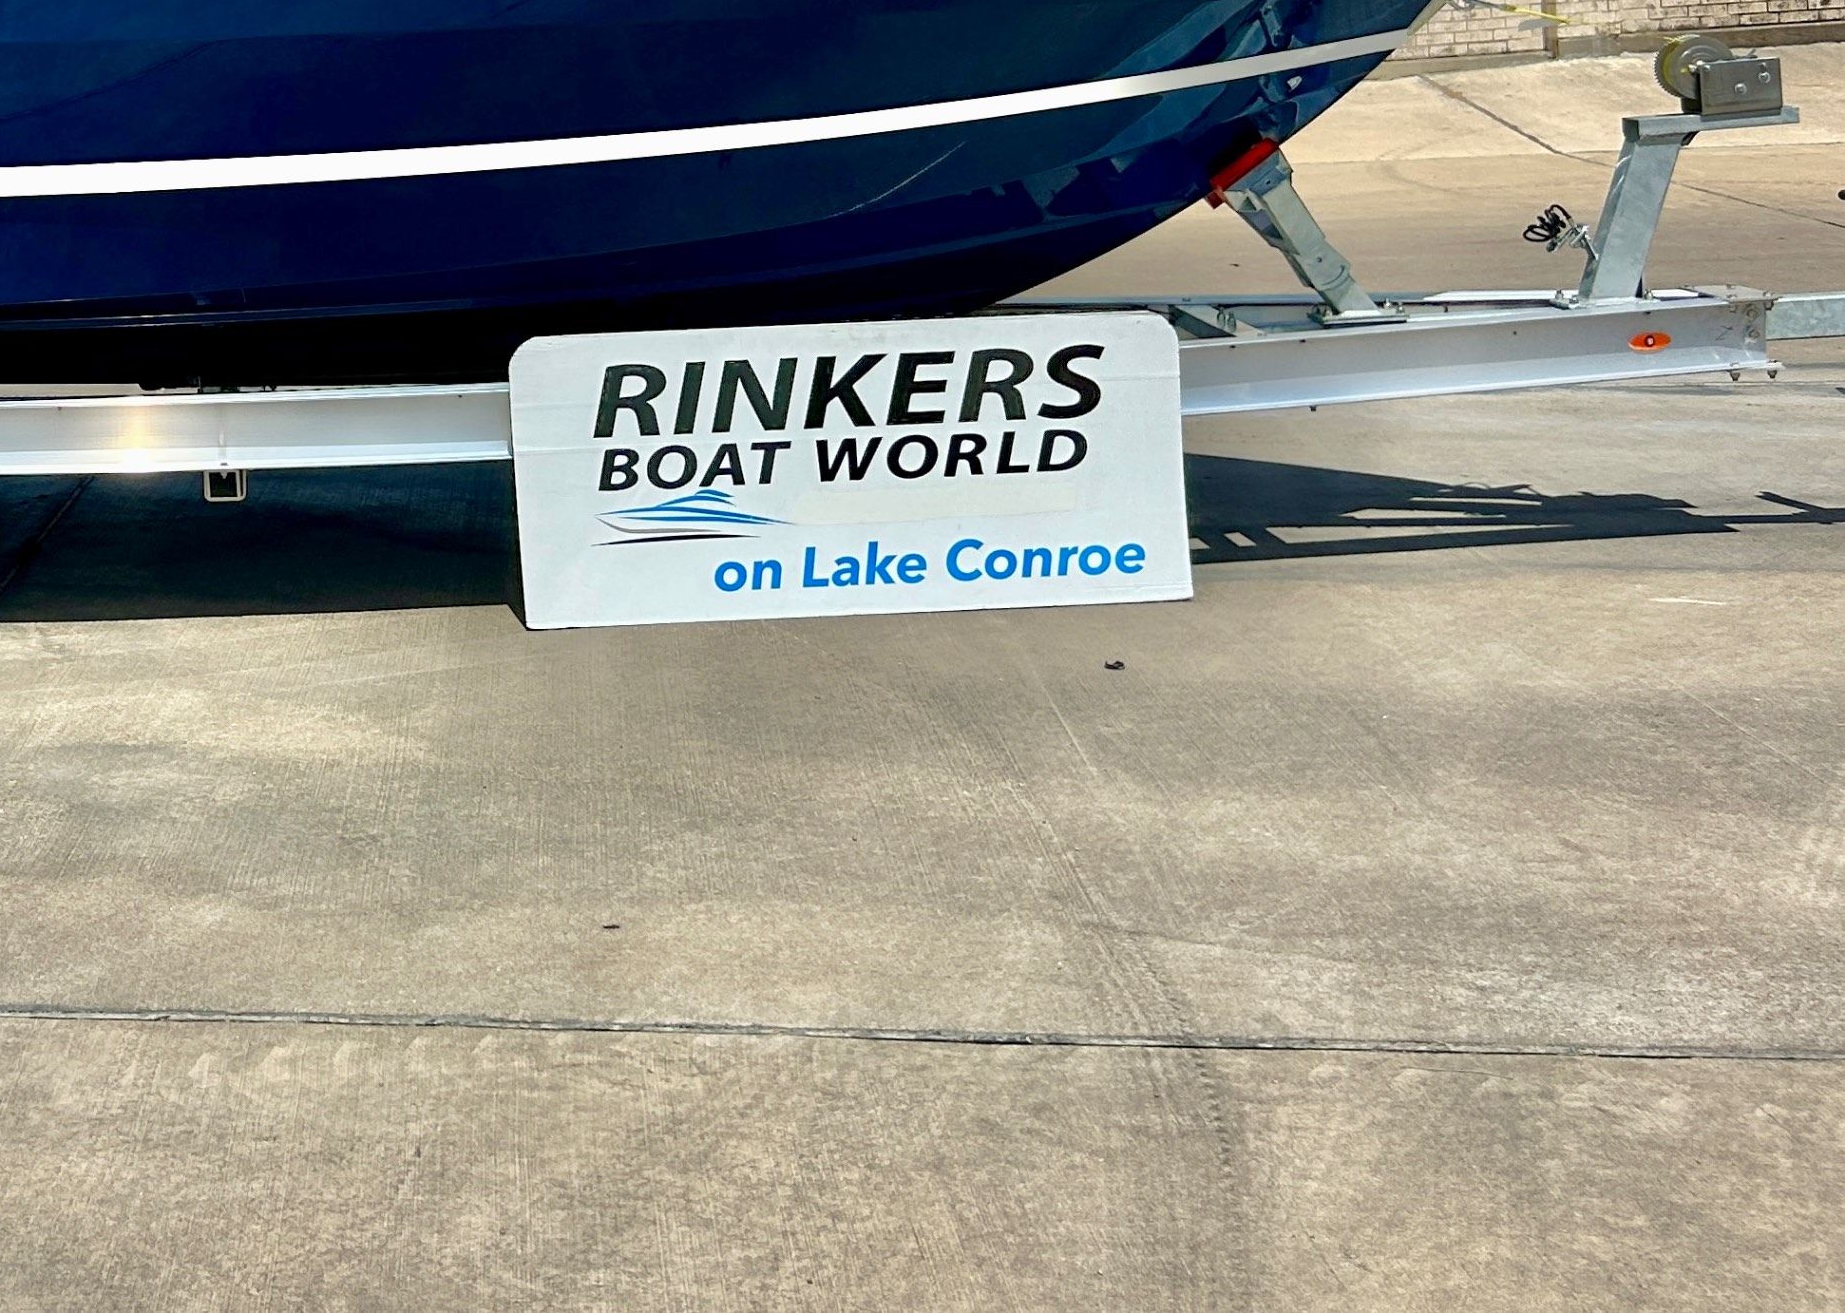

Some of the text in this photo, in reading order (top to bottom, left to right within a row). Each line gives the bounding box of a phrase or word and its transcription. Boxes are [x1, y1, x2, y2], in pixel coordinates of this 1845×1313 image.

[593, 344, 1105, 439] RINKERS
[598, 429, 1088, 492] BOAT WORLD
[714, 538, 1146, 593] on Lake Conroe
